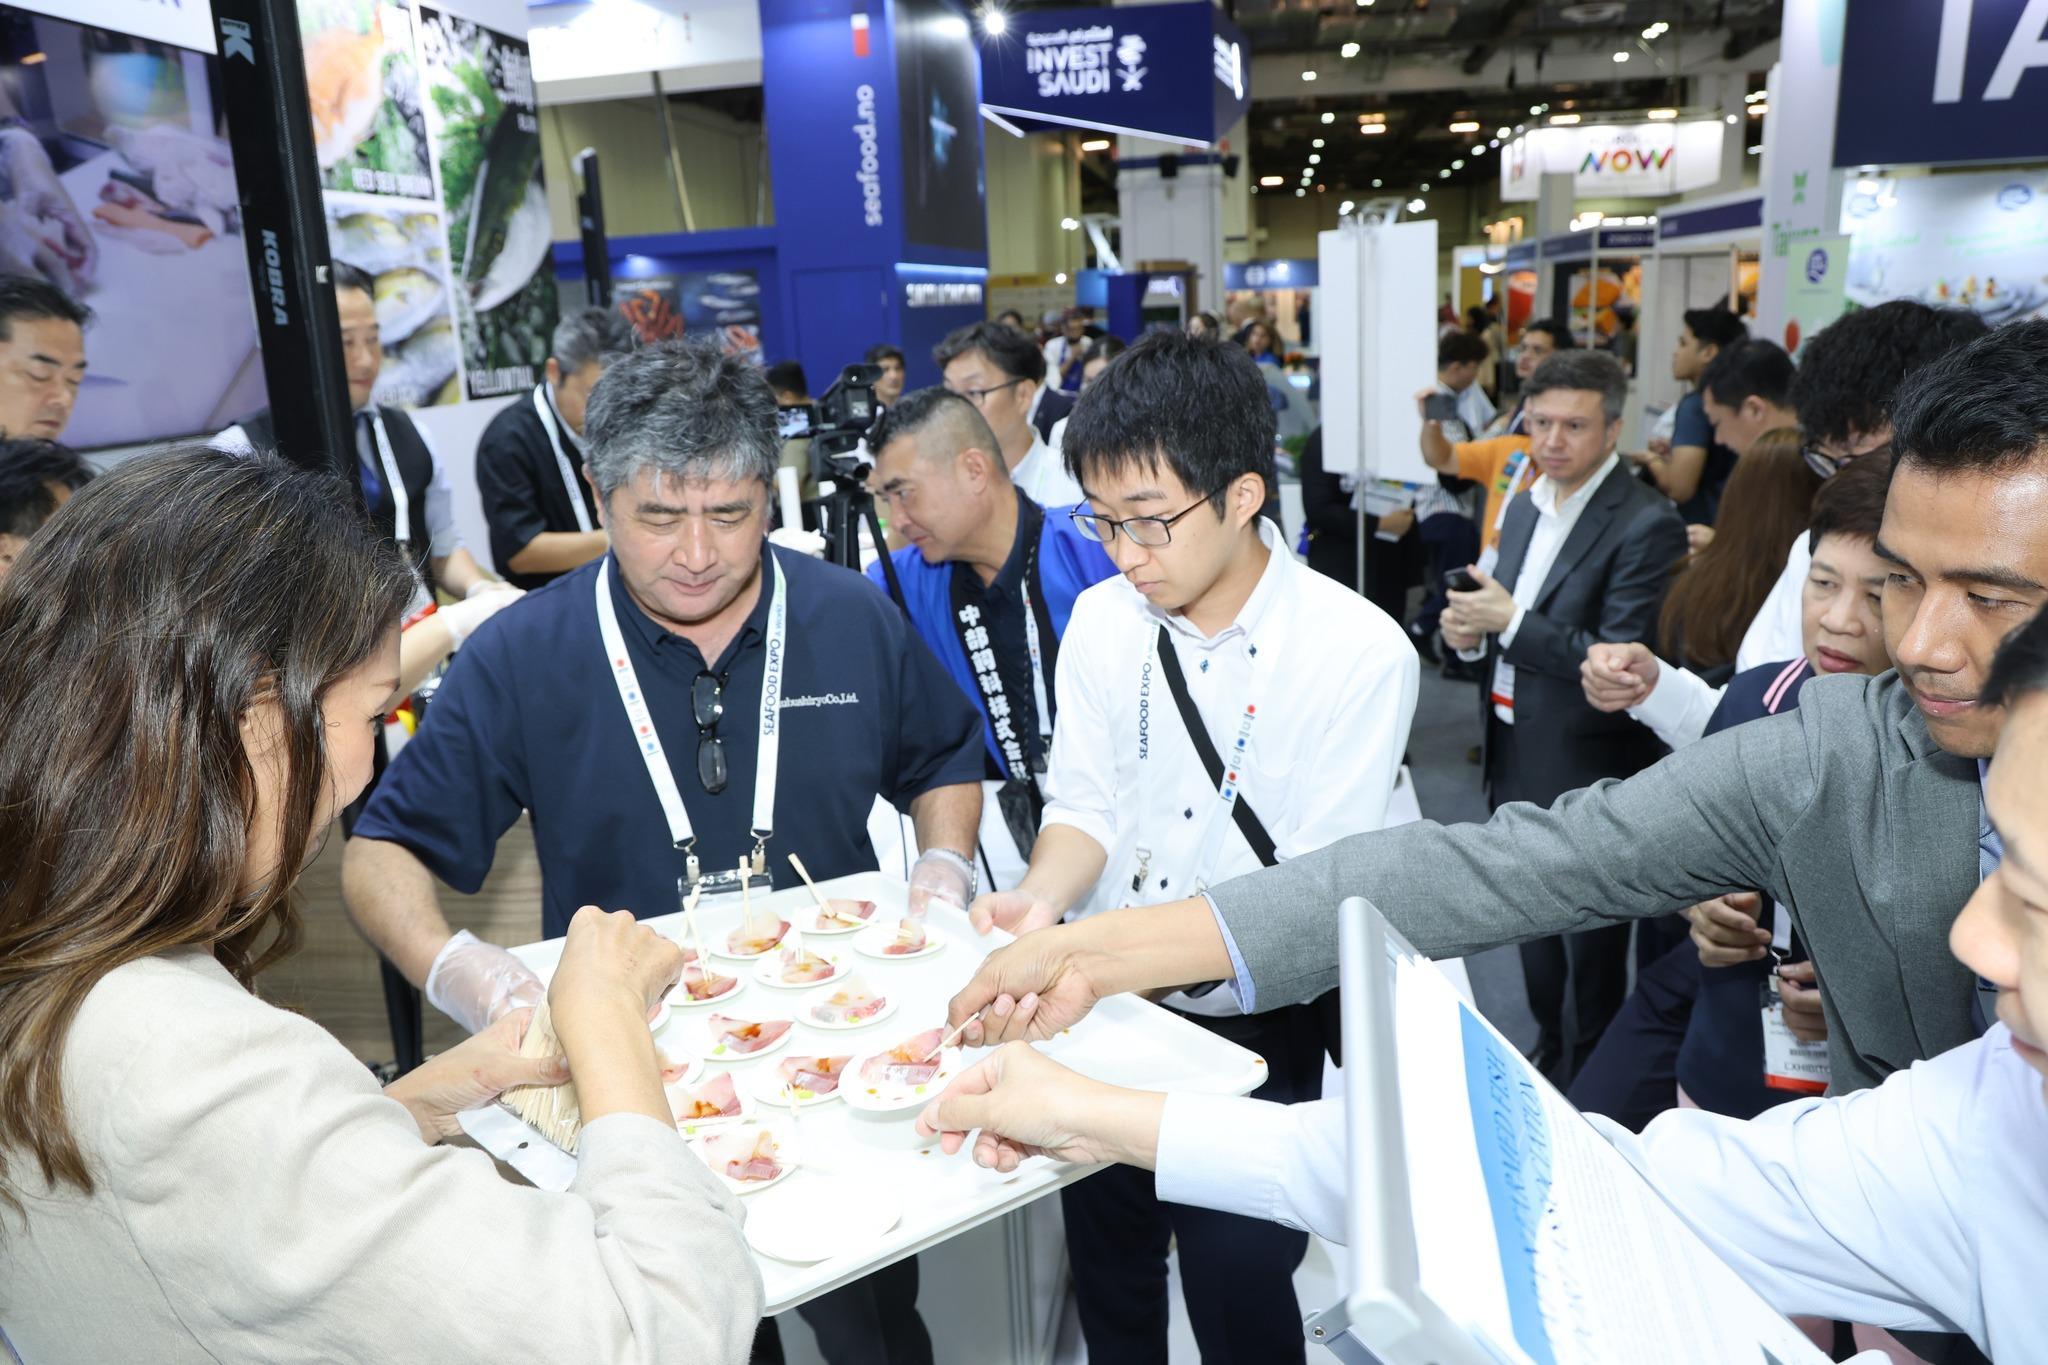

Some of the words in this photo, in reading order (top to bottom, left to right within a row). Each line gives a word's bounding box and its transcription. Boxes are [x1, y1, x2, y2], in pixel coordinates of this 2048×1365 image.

[1026, 42, 1113, 74] INVEST
[1038, 68, 1110, 97] SAUDI
[853, 84, 883, 226] seafood.no
[1579, 147, 1675, 173] NOW
[261, 228, 289, 325] KOBRA
[769, 638, 781, 673] EXPO
[1140, 662, 1152, 697] EXPO
[763, 674, 778, 736] SEAFOOD
[1139, 699, 1149, 760] SEAFOOD
